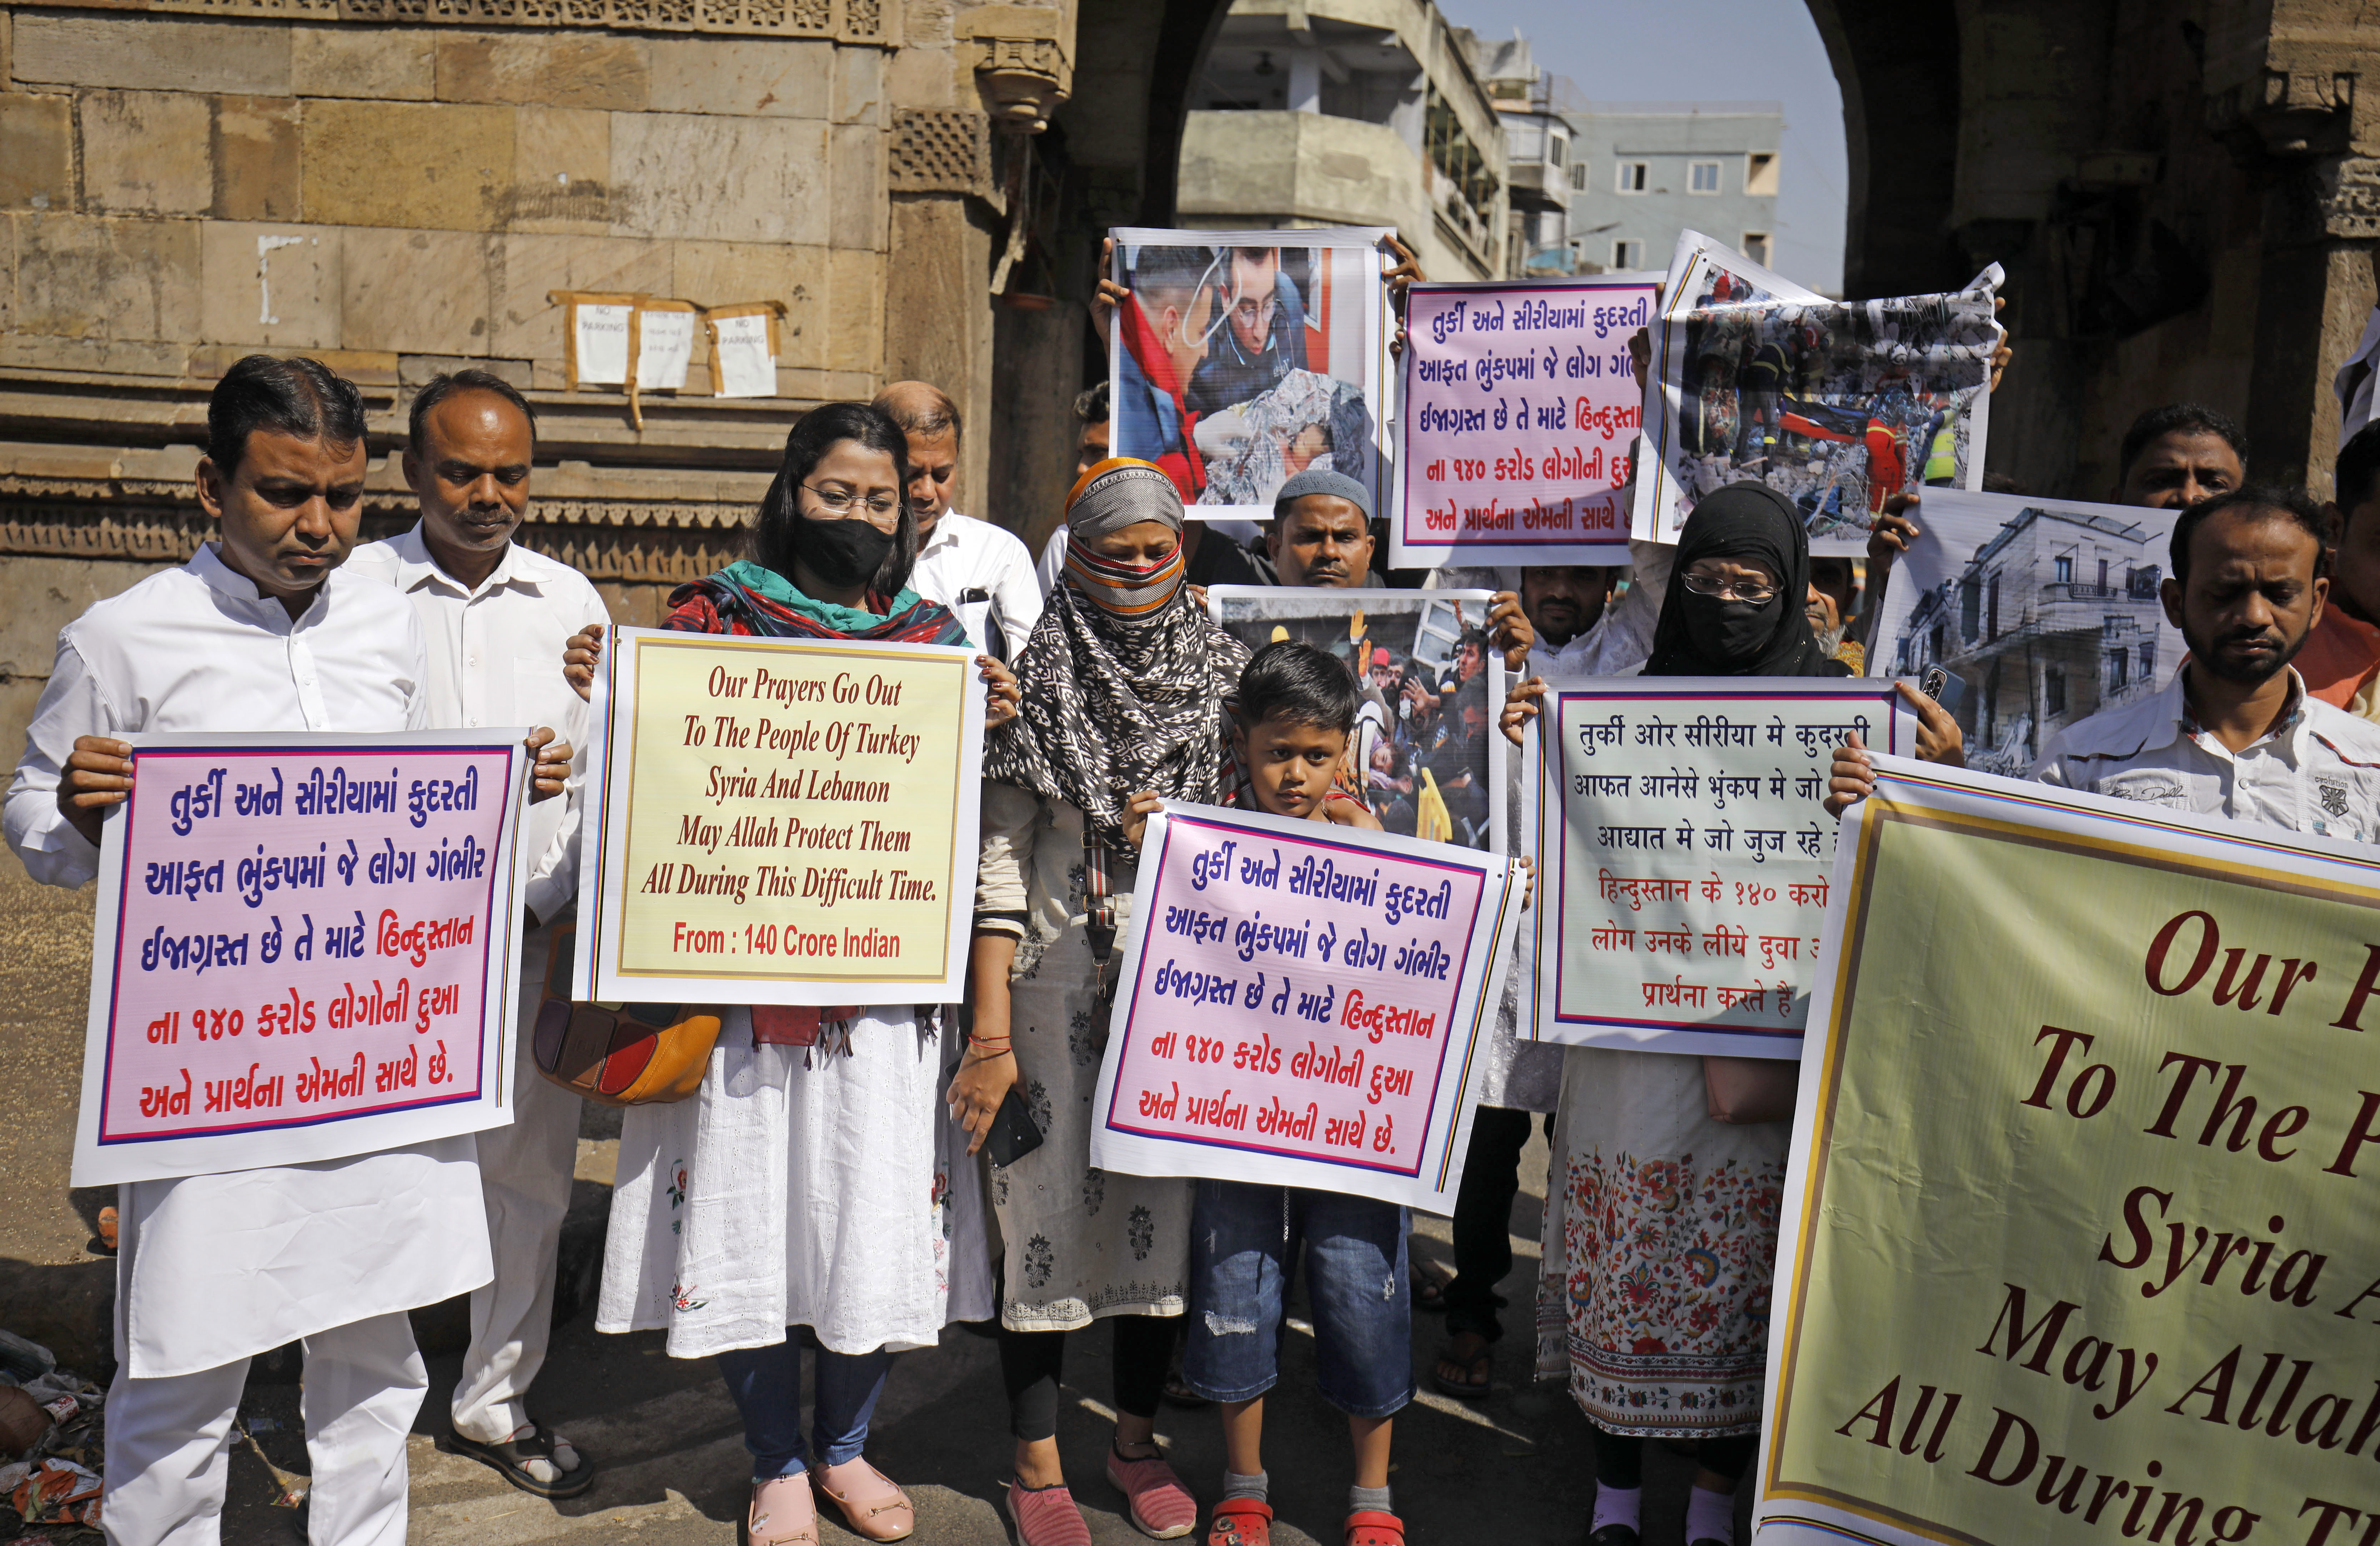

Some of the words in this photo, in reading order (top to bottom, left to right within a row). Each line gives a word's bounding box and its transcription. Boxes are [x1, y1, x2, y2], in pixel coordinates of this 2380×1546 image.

[582, 321, 624, 332] PARKING
[596, 306, 611, 316] NO
[735, 319, 749, 328] NO
[1433, 301, 1467, 343] તુર્કી
[1473, 300, 1503, 331] અને
[1513, 300, 1585, 329] સીરીયામાં
[1594, 297, 1646, 338] કુદરતી
[722, 335, 765, 344] PARKING
[1419, 360, 1466, 386] આફત
[1543, 347, 1558, 378] જે
[1566, 346, 1600, 378] લોગ
[1494, 398, 1507, 430] છે
[1517, 397, 1528, 429] તે
[1538, 397, 1566, 429] માટે
[1575, 396, 1641, 439] હિન્દુસ્તા
[1427, 460, 1445, 481] ના
[1454, 459, 1485, 481] ૧૪૦
[1495, 448, 1533, 480] કરોડ
[1543, 447, 1602, 479] લોગોની
[1426, 499, 1456, 530] અને
[1465, 499, 1513, 530] પ્રાર્થના
[1523, 498, 1572, 529] એમની
[1582, 497, 1614, 529] સાથે
[709, 666, 747, 698] Our
[752, 669, 826, 709] Prayers
[833, 673, 859, 704] Go
[866, 675, 902, 706] Out
[683, 715, 706, 746] To
[713, 716, 750, 748] The
[754, 719, 819, 759] People
[826, 721, 854, 761] Of
[855, 723, 920, 764] Turkey
[1580, 715, 1625, 756] तुर्की
[1635, 715, 1677, 747] ओर
[1684, 715, 1757, 747] सीरीया
[1766, 715, 1785, 747] मे
[171, 769, 227, 836] તુર્કી
[235, 767, 283, 817] અને
[295, 766, 397, 815] સીરીયામાં
[408, 765, 477, 828] કુદરતી
[706, 766, 757, 806] Syria
[760, 768, 804, 799] And
[805, 770, 889, 802] Lebanon
[1575, 775, 1632, 797] आफत
[1640, 767, 1699, 798] आनेसे
[1708, 770, 1761, 809] भुंकप
[1769, 768, 1787, 800] मे
[1796, 768, 1822, 801] जो
[2315, 776, 2348, 789] evolution
[677, 815, 722, 855] May
[725, 816, 778, 847] Allah
[783, 818, 853, 850] Protect
[859, 821, 910, 851] Them
[1676, 819, 1694, 850] मे
[1704, 820, 1734, 851] जो
[1744, 830, 1787, 863] जुज
[1796, 821, 1822, 858] रहे
[145, 860, 224, 901] આફત
[338, 839, 359, 886] જે
[369, 838, 416, 884] લોગ
[426, 835, 485, 881] ગંભીર
[641, 863, 674, 893] All
[676, 864, 749, 905] During
[755, 866, 796, 897] This
[801, 868, 883, 907] Difficult
[889, 870, 935, 901] Time.
[1192, 841, 1237, 891] તુર્કી
[1241, 848, 1281, 889] અને
[1289, 855, 1379, 906] સીરીયામાં
[1385, 880, 1451, 925] કુદરતી
[1598, 868, 1691, 911] हिन्दुस्तान
[1701, 871, 1723, 903] के
[1736, 882, 1776, 905] १४०
[1788, 875, 1829, 908] करो
[261, 916, 282, 963] છે
[295, 914, 313, 961] તે
[325, 911, 365, 958] માટે
[377, 909, 474, 967] હિન્દુસ્તાન
[674, 922, 724, 953] From
[745, 924, 777, 955] 140
[784, 925, 837, 957] Crore
[844, 927, 899, 957] Indian
[1166, 906, 1228, 945] આફત
[1318, 922, 1336, 962] જે
[1344, 928, 1387, 971] લોગ
[1394, 938, 1450, 980] ગંભીર
[1592, 920, 1636, 952] लोग
[1644, 923, 1692, 955] उनके
[1702, 925, 1748, 957] लीये
[1759, 936, 1800, 969] दुवा
[2145, 911, 2317, 1016] Our
[147, 1012, 179, 1044] ના
[193, 1008, 243, 1041] ૧૪૦
[258, 987, 316, 1037] કરોડ
[328, 978, 409, 1028] લોગોની
[415, 984, 458, 1034] દુઆ
[1244, 972, 1265, 1009] છે
[1272, 977, 1291, 1015] તે
[1297, 984, 1335, 1023] માટે
[1340, 989, 1436, 1044] હિન્દુસ્તાન
[1642, 975, 1708, 1008] प्रार्थना
[1717, 980, 1767, 1012] करते
[1777, 981, 1793, 1018] है
[140, 1068, 192, 1117] અને
[205, 1063, 283, 1113] પ્રાર્થના
[296, 1052, 365, 1103] એમની
[376, 1044, 417, 1092] સાથે
[428, 1040, 452, 1084] છે.
[1152, 1032, 1177, 1059] ના
[1186, 1035, 1224, 1063] ૧૪૦
[1234, 1033, 1281, 1074] કરોડ
[1291, 1041, 1364, 1088] લોગોની
[1367, 1065, 1413, 1104] દુઆ
[2020, 1025, 2116, 1118] To
[2143, 1051, 2309, 1162] The
[1139, 1082, 1179, 1121] અને
[1186, 1089, 1248, 1130] પ્રાર્થના
[1256, 1096, 1317, 1141] એમની
[1325, 1110, 1366, 1148] સાથે
[1373, 1114, 1395, 1154] છે.
[2098, 1186, 2328, 1307] Syria
[1975, 1282, 2158, 1420] May
[1835, 1375, 1962, 1463] All
